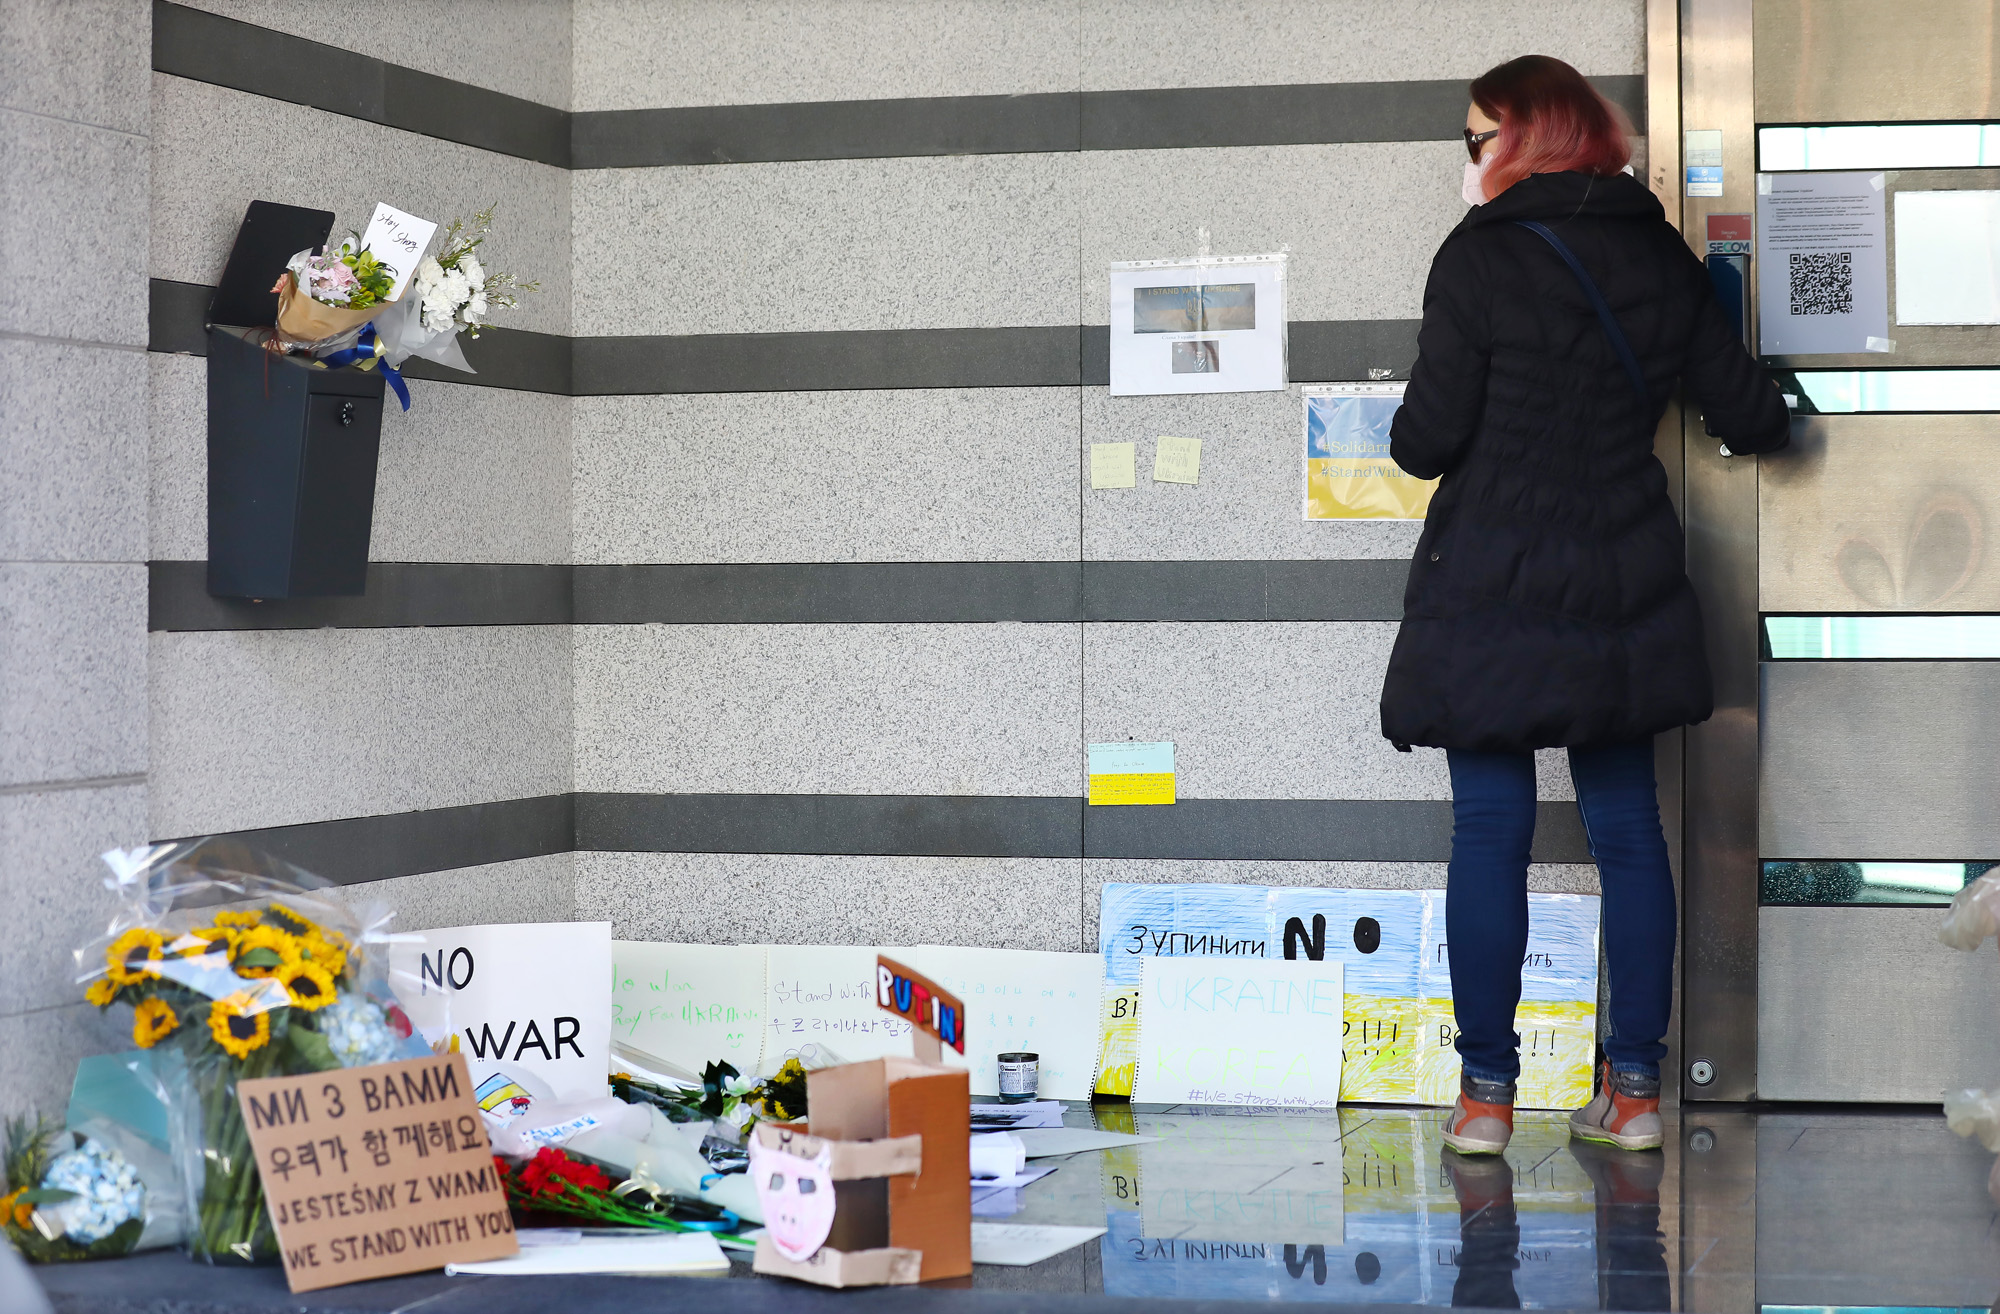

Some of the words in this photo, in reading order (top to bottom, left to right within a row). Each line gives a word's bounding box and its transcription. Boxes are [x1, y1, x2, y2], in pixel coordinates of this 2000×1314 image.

[1709, 242, 1750, 253] SECOM
[1153, 287, 1179, 296] STAND
[1204, 284, 1241, 294] UKRAINE
[1322, 440, 1391, 453] #Solidarn
[1321, 466, 1414, 478] #StandWith
[421, 946, 475, 996] NO
[774, 980, 833, 1005] Stand
[878, 964, 966, 1056] PUTIN!
[1156, 976, 1337, 1017] UKRAINE
[465, 1016, 585, 1061] WAR
[1156, 1045, 1314, 1090] KOREA
[249, 1087, 309, 1130] МИ
[361, 1063, 460, 1113] ВАМИ
[269, 1134, 349, 1182] 우리가
[279, 1182, 397, 1225] JESTEŚMY
[405, 1180, 422, 1203] Z
[428, 1166, 499, 1200] WAMI
[289, 1242, 321, 1270] WE
[330, 1228, 407, 1263] STAND
[408, 1216, 470, 1248] WITH
[477, 1207, 513, 1238] YOU
